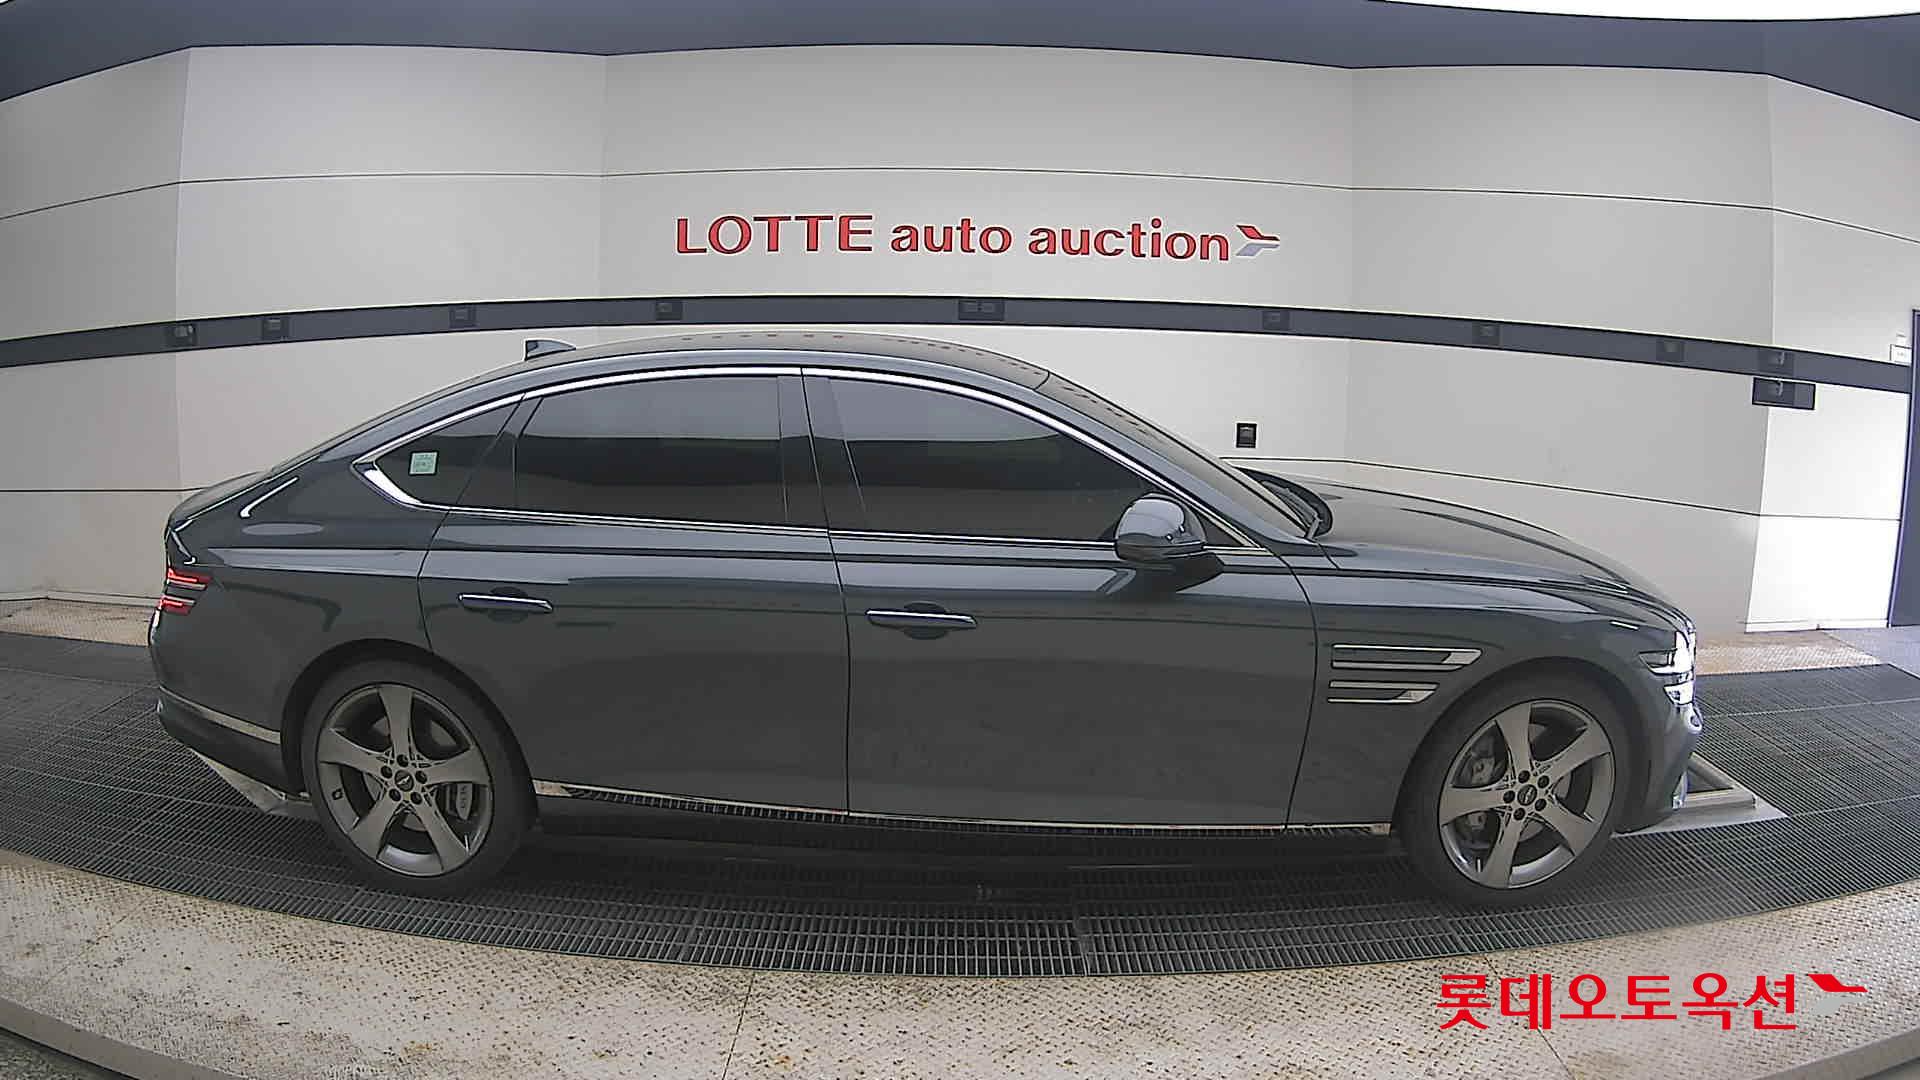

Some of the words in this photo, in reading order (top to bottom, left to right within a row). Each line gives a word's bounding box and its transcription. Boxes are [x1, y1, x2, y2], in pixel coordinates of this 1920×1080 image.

[676, 214, 873, 254] LOTTE
[890, 217, 1013, 255] auto
[1028, 217, 1231, 262] auction
